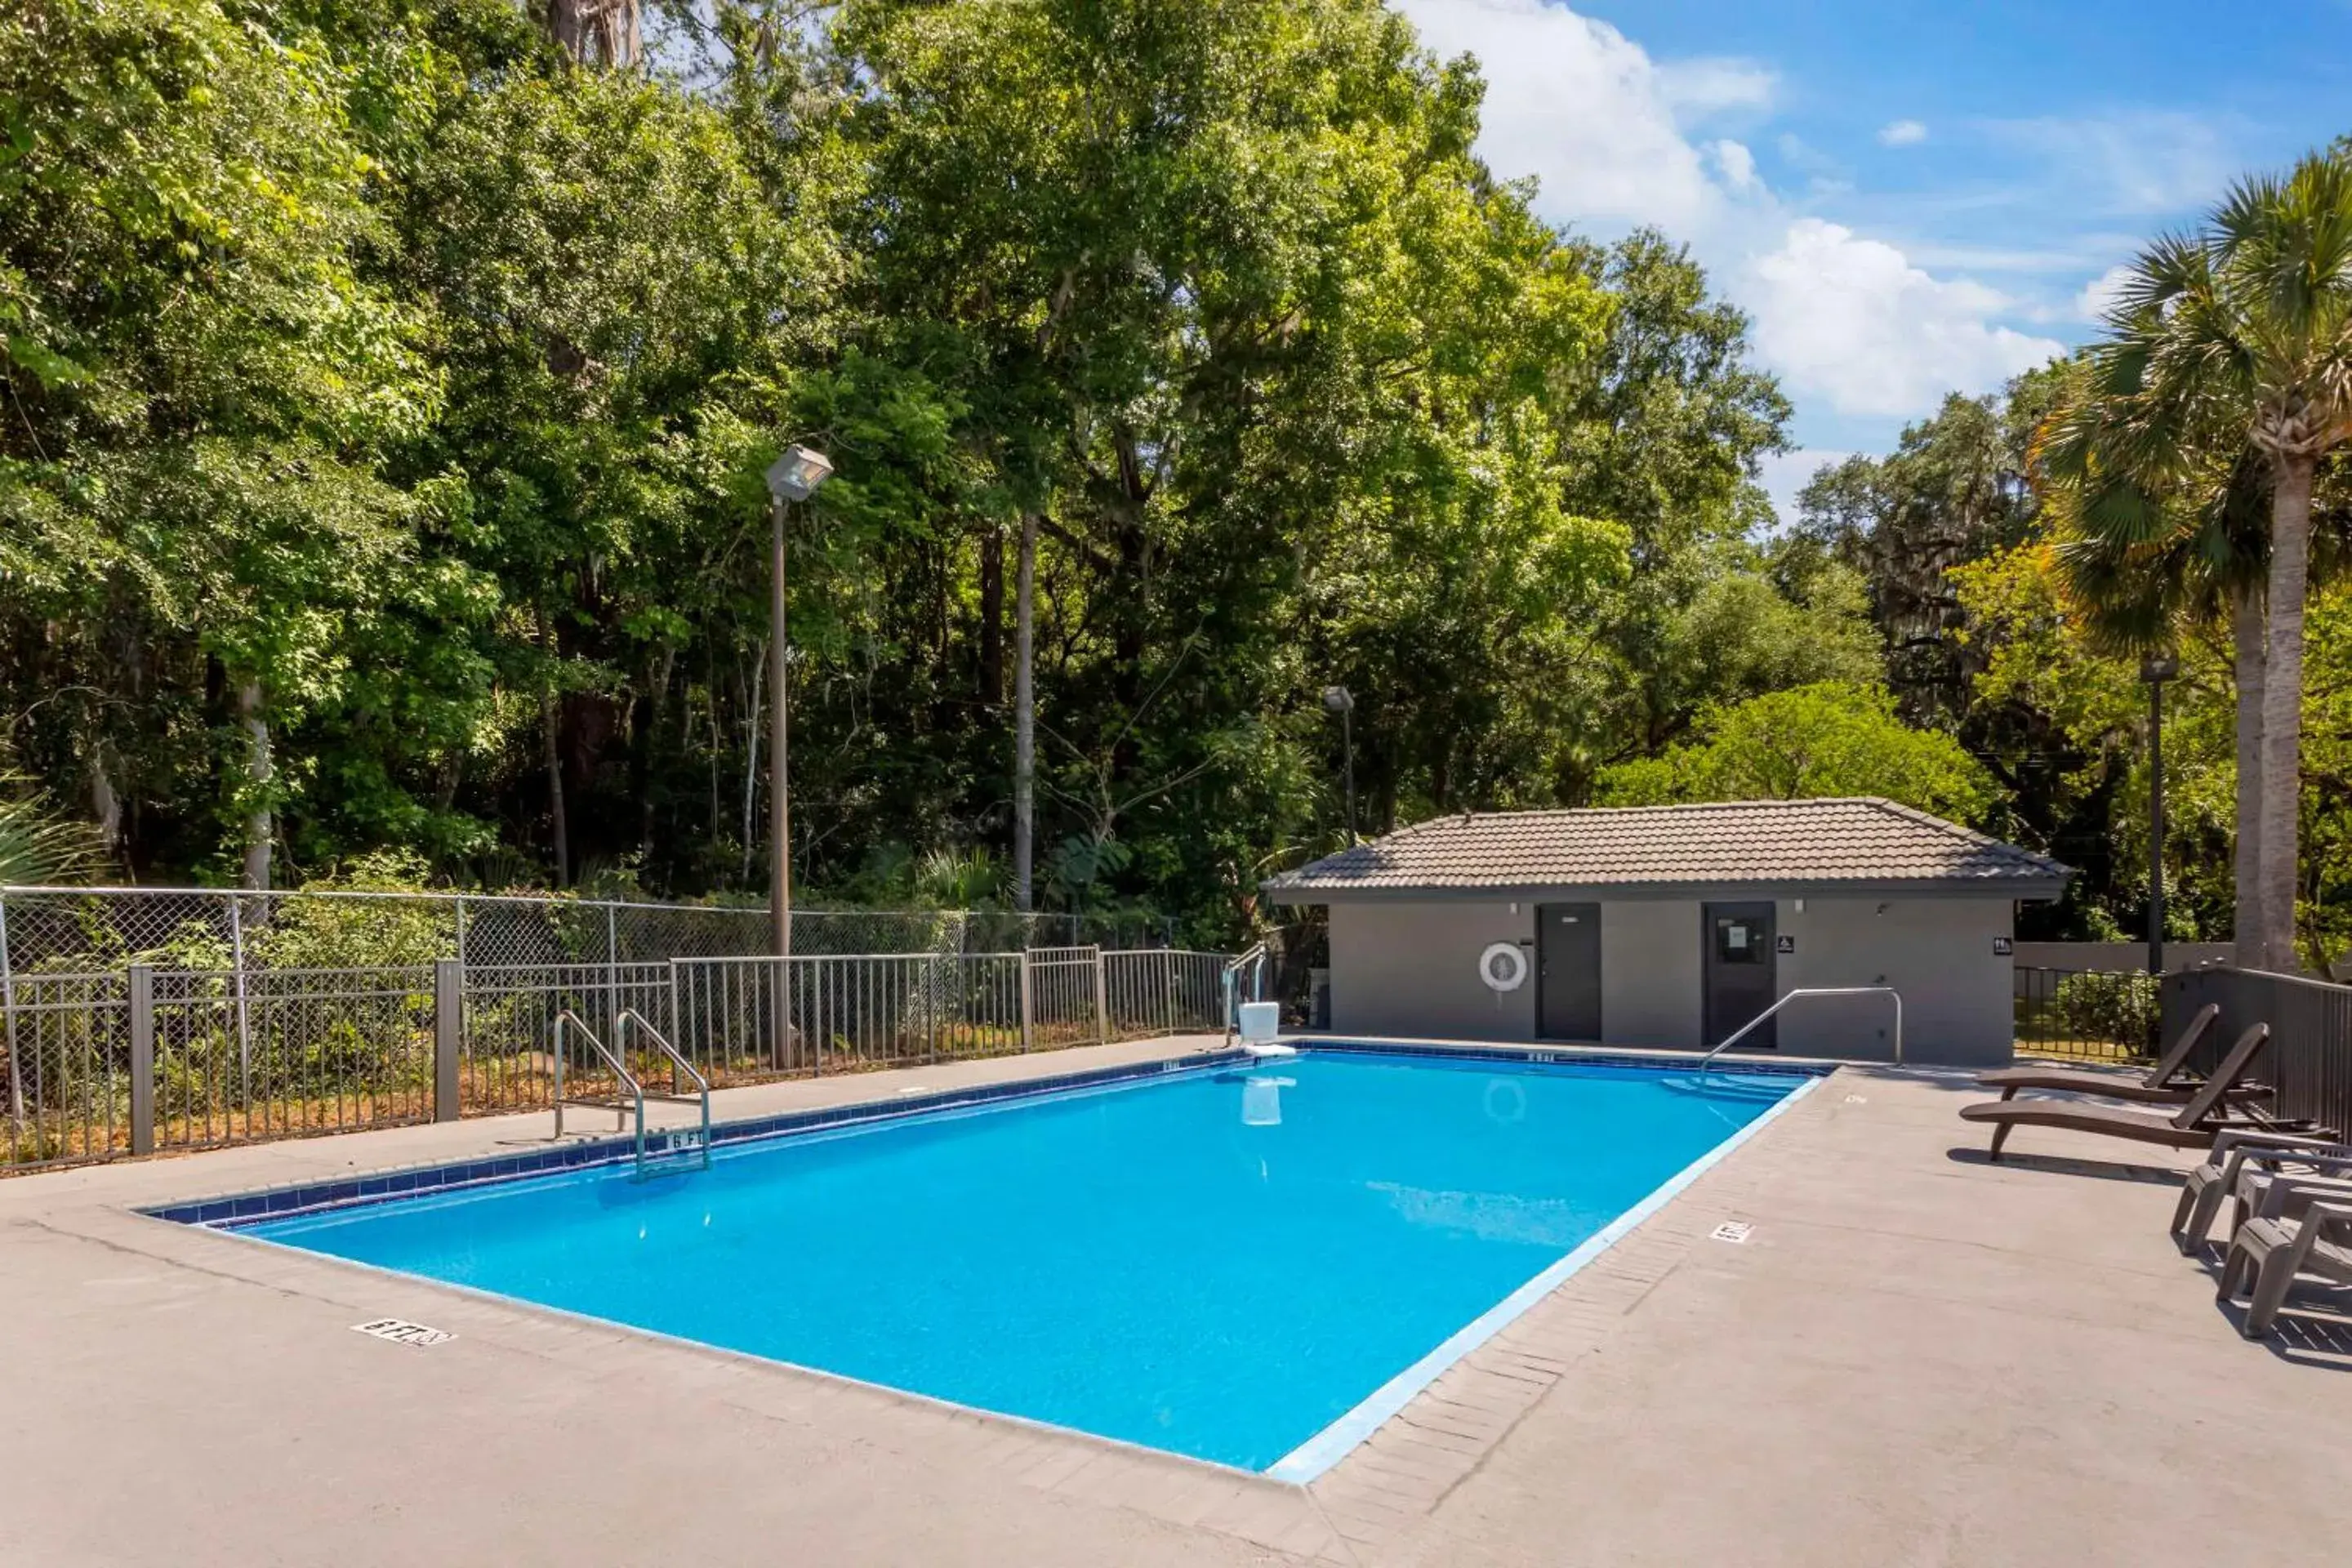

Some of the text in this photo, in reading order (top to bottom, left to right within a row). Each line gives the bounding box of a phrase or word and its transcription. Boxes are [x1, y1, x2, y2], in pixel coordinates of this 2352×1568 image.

[674, 1129, 703, 1148] 6 FT
[380, 1325, 429, 1339] FT
